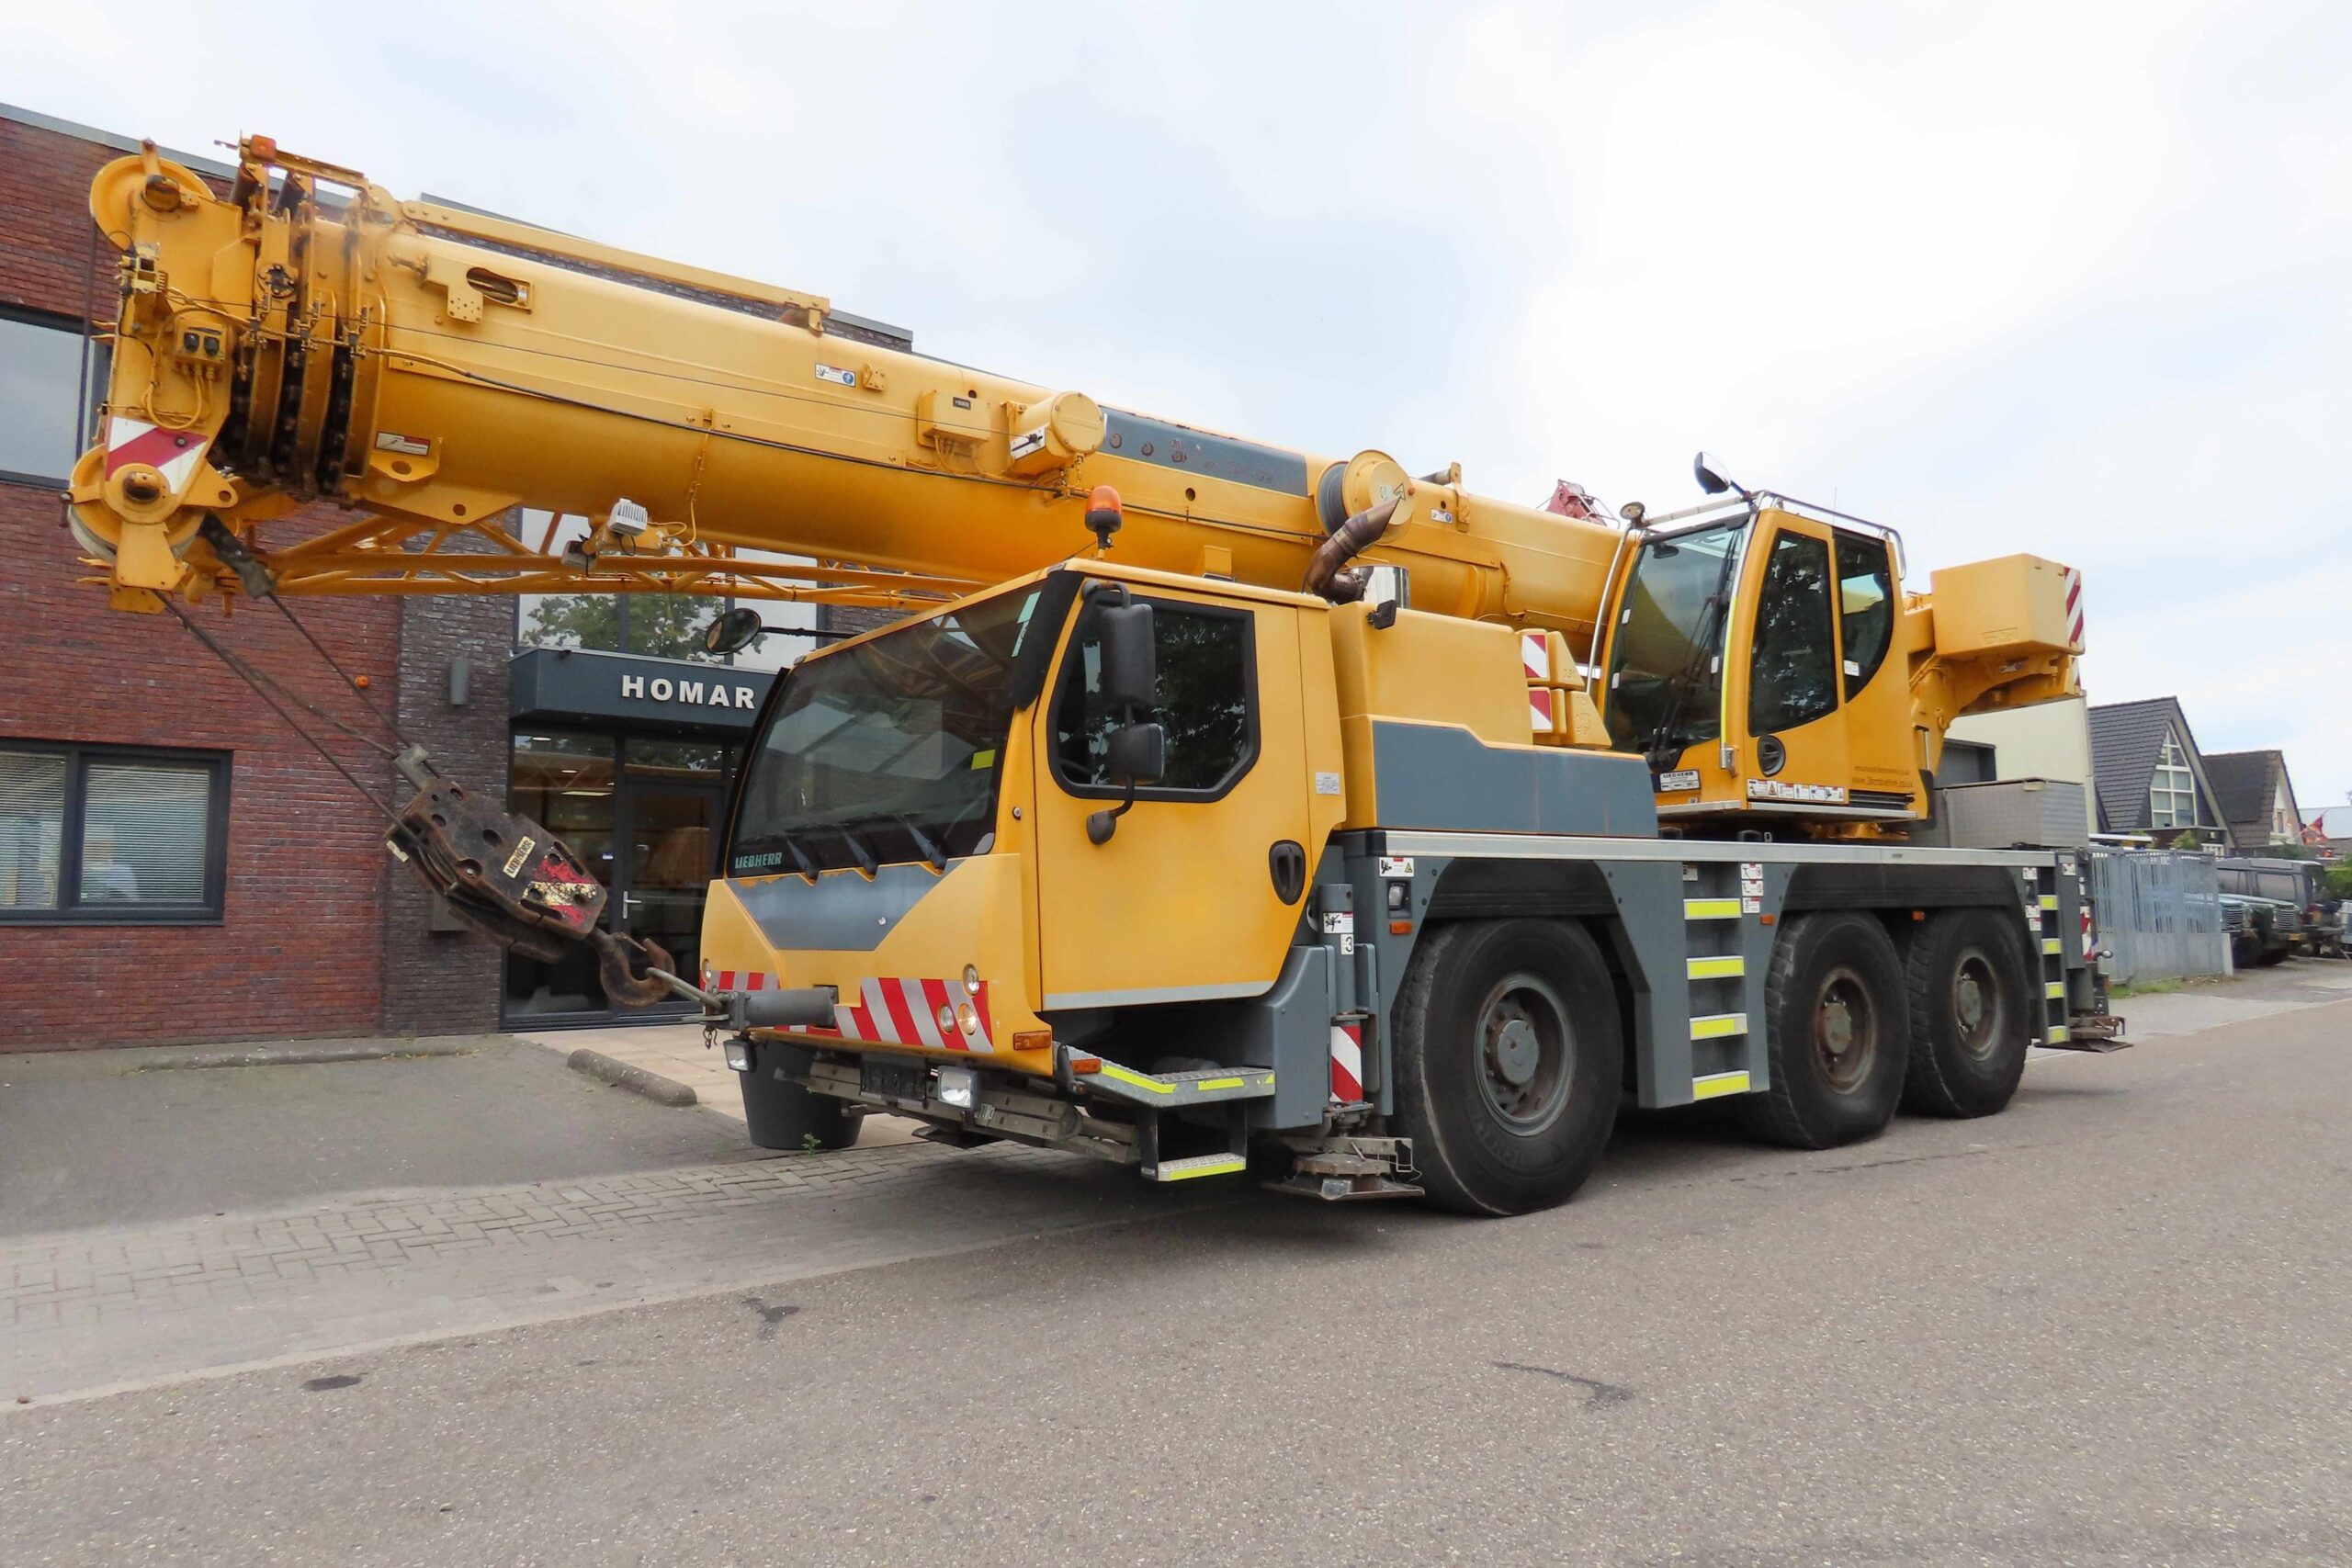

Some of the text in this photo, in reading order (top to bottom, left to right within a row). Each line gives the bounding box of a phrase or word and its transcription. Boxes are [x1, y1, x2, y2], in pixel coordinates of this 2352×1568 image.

[622, 675, 755, 709] HOMAR
[735, 852, 783, 869] LIEBHERR
[1345, 936, 1353, 953] 3
